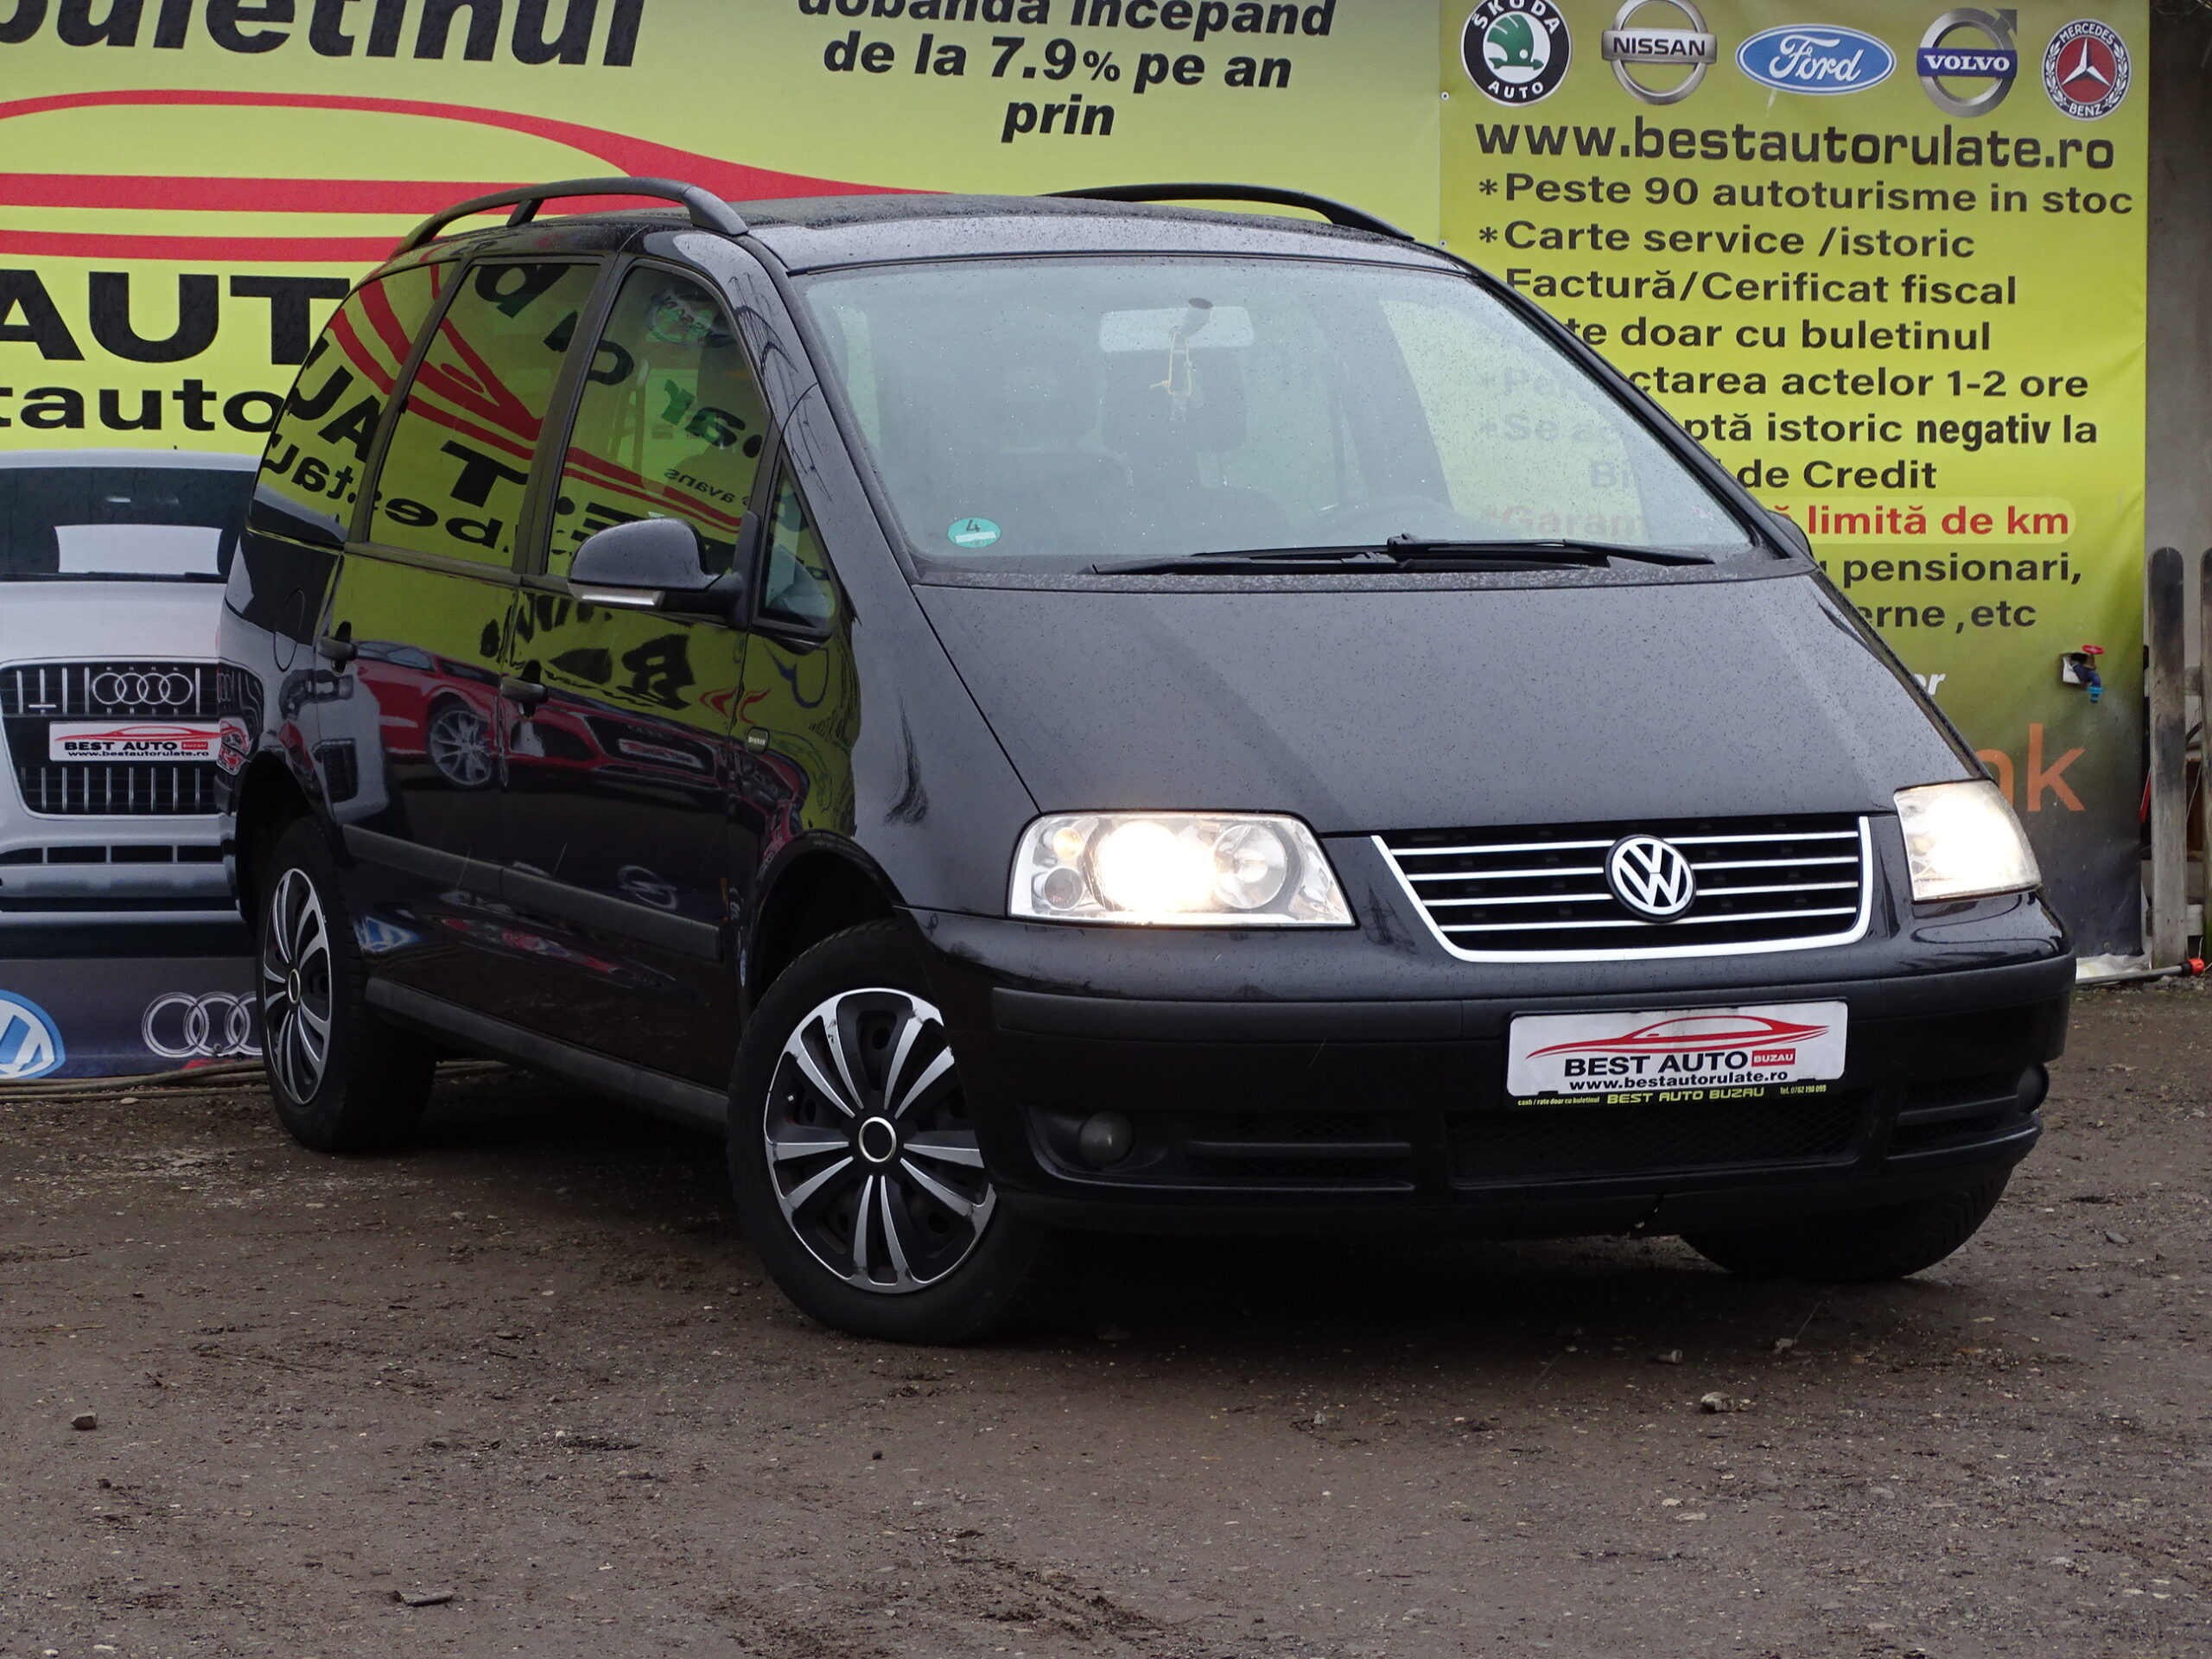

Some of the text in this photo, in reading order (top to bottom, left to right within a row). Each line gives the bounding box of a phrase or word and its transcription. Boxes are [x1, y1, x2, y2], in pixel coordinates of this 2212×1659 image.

[0, 0, 643, 67] uletinul
[1613, 37, 1706, 56] NISSAN
[2059, 22, 2115, 45] MERCEDES
[823, 30, 1292, 94] de la 7.9% pe an
[1769, 35, 1864, 81] Ford
[1924, 54, 2010, 72] VOLVO
[1488, 80, 1544, 99] AUTO
[1001, 93, 1116, 143] prin
[2069, 103, 2103, 117] BENZ
[1475, 115, 2114, 169] www.bestautorulate.ro
[1645, 177, 1699, 206] 90
[1713, 180, 1977, 212] autoturisme
[1991, 183, 2028, 213] in
[2042, 187, 2133, 214] stoc
[1643, 224, 1805, 254] service
[1818, 226, 1975, 258] /istoric
[1901, 274, 2016, 305] fiscal
[0, 269, 350, 366] AUT
[1620, 316, 1723, 346] doar
[1735, 326, 1786, 348] cu
[1802, 319, 1990, 350] buletinul
[1782, 367, 1934, 397] actelor
[1947, 370, 2006, 397] 1-2
[2020, 376, 2088, 397] ore
[1768, 412, 1903, 442] istoric
[1916, 412, 2051, 452] negativ
[2063, 415, 2097, 443] la
[1737, 459, 1937, 489] de Credit
[1808, 505, 1927, 535] limită
[1942, 505, 1993, 535] de
[2007, 505, 2069, 535] km
[1843, 552, 2082, 588] pensionari,
[65, 741, 115, 751] BEST
[123, 741, 177, 751] AUTO
[1565, 1051, 1794, 1077] BEST AUTO BUZAU
[1569, 1071, 1788, 1090] www.bestautorulate.ro
[1607, 1093, 1654, 1104] BEST
[1659, 1090, 1704, 1102] AUTO
[1708, 1087, 1765, 1100] BUZAU
